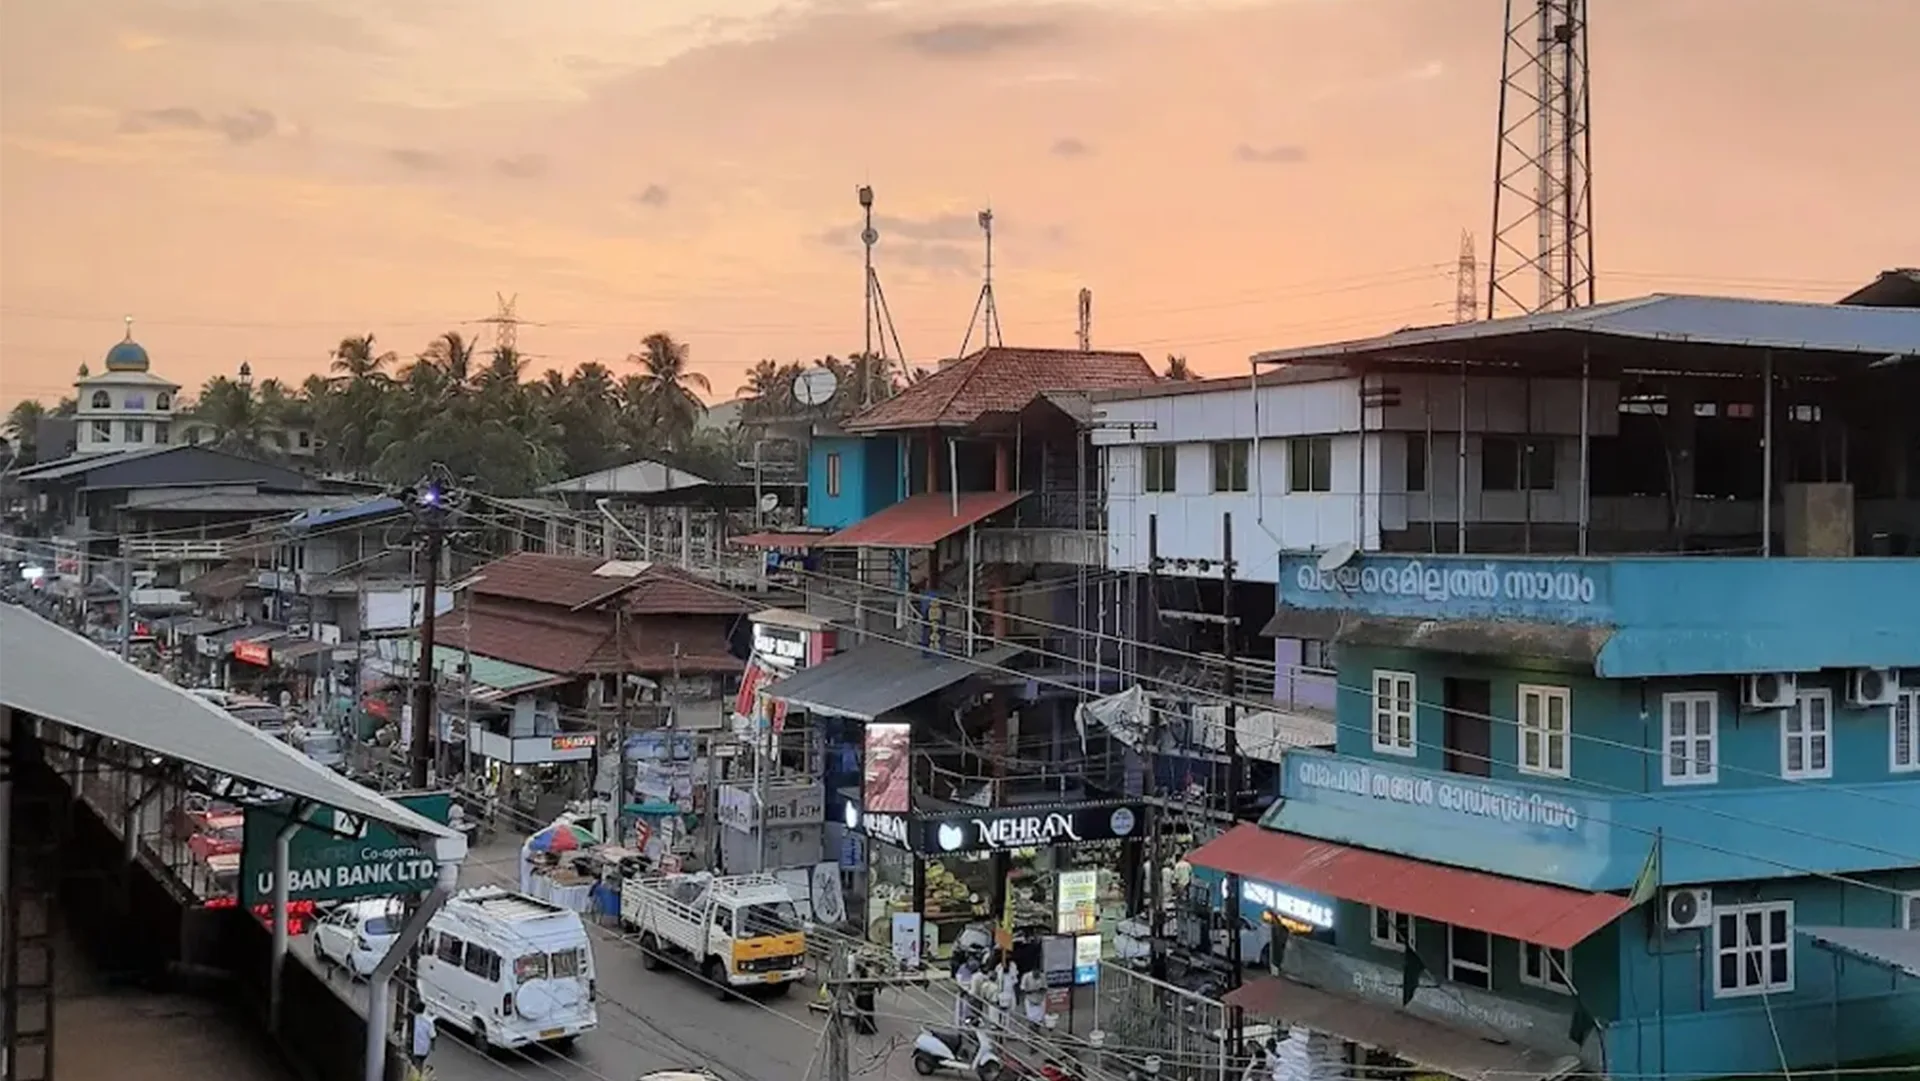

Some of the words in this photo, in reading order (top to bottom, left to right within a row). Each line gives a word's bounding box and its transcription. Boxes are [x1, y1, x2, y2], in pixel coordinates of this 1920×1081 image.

[971, 812, 1083, 848] MEHRAN
[361, 847, 423, 860] Co-opera
[257, 867, 331, 895] UBAN
[336, 862, 394, 888] BANK
[397, 858, 438, 881] LTD.
